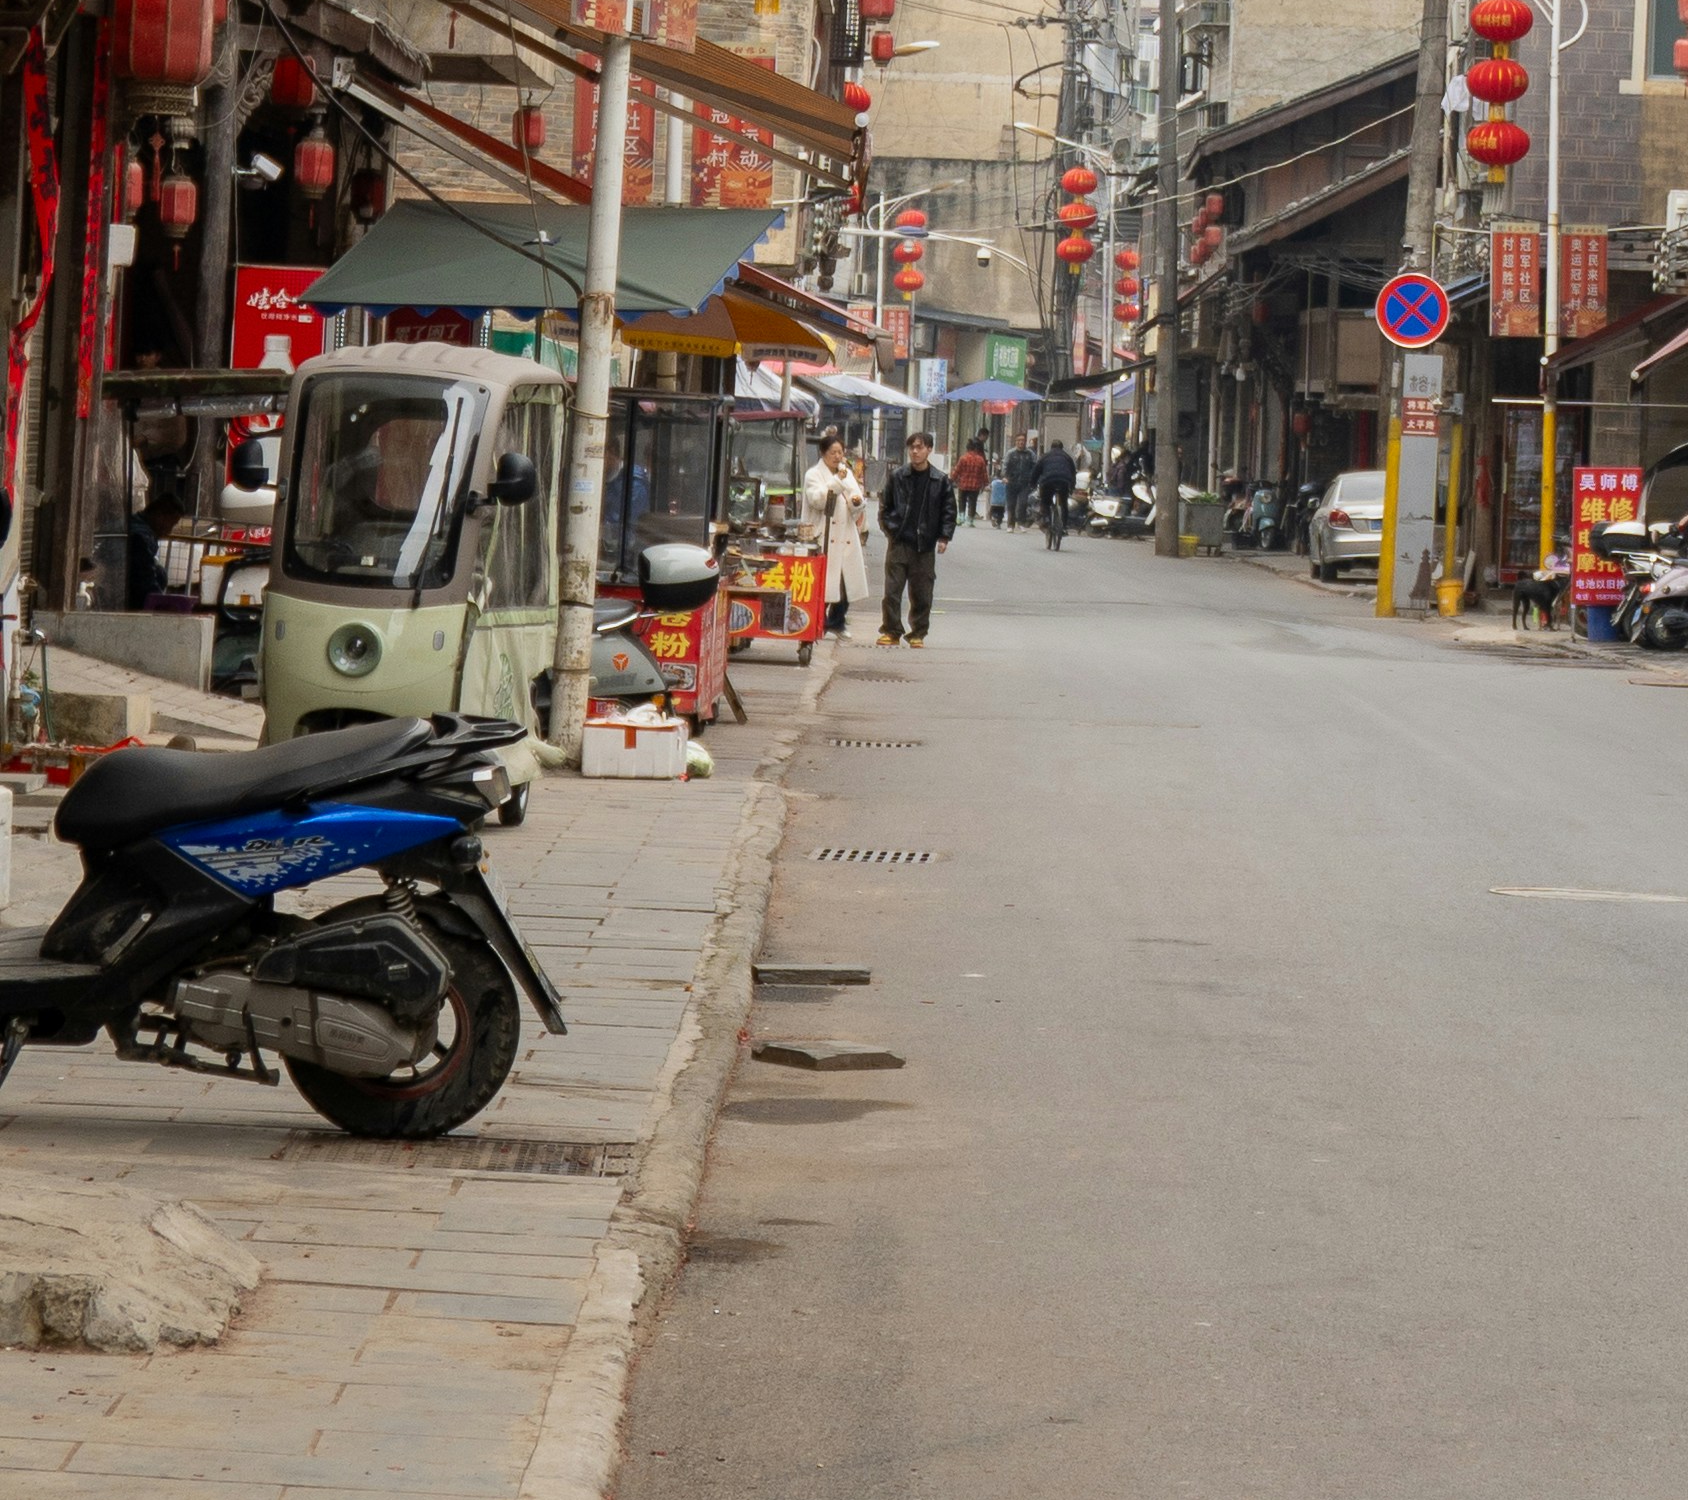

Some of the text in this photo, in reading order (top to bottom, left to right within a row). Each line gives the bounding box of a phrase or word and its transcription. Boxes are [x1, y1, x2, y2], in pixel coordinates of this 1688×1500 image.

[1502, 237, 1514, 302] 村超胜地
[1519, 238, 1531, 303] 冠军社区
[1571, 238, 1583, 311] 奥运冠军村
[1587, 240, 1599, 310] 全民来运动
[1579, 474, 1639, 492] 吴师傅
[1580, 497, 1634, 524] 维修
